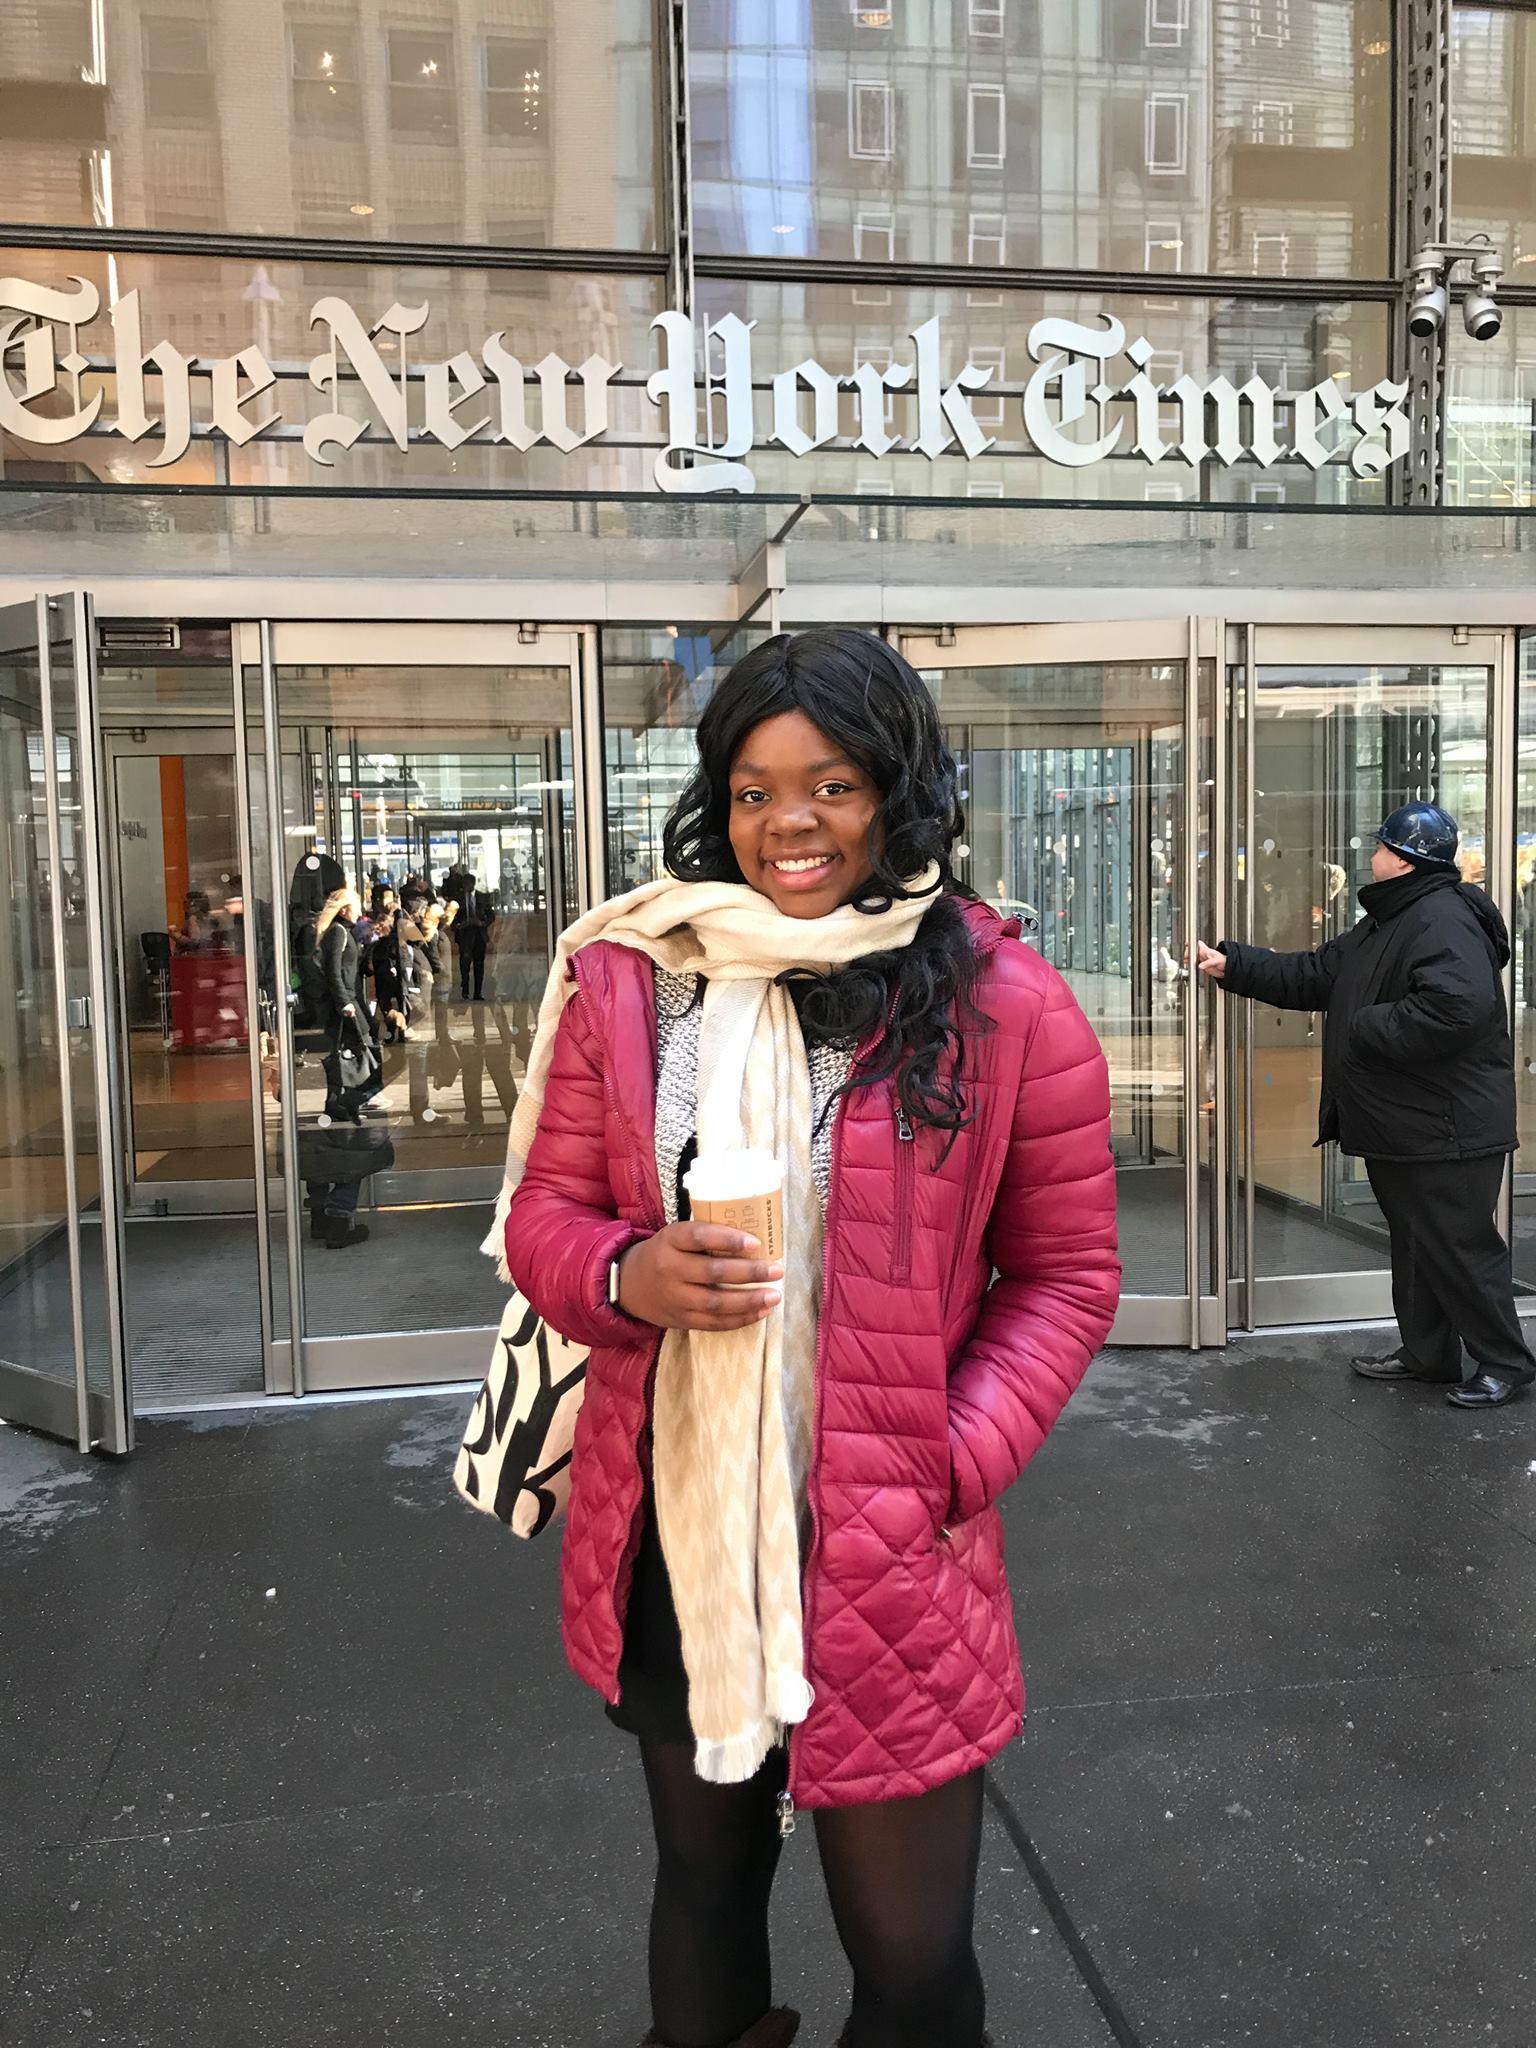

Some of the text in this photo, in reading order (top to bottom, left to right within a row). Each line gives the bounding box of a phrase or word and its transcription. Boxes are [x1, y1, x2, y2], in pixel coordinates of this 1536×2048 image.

[0, 275, 1412, 495] The New York Times
[766, 1199, 774, 1255] STARBUCKS
